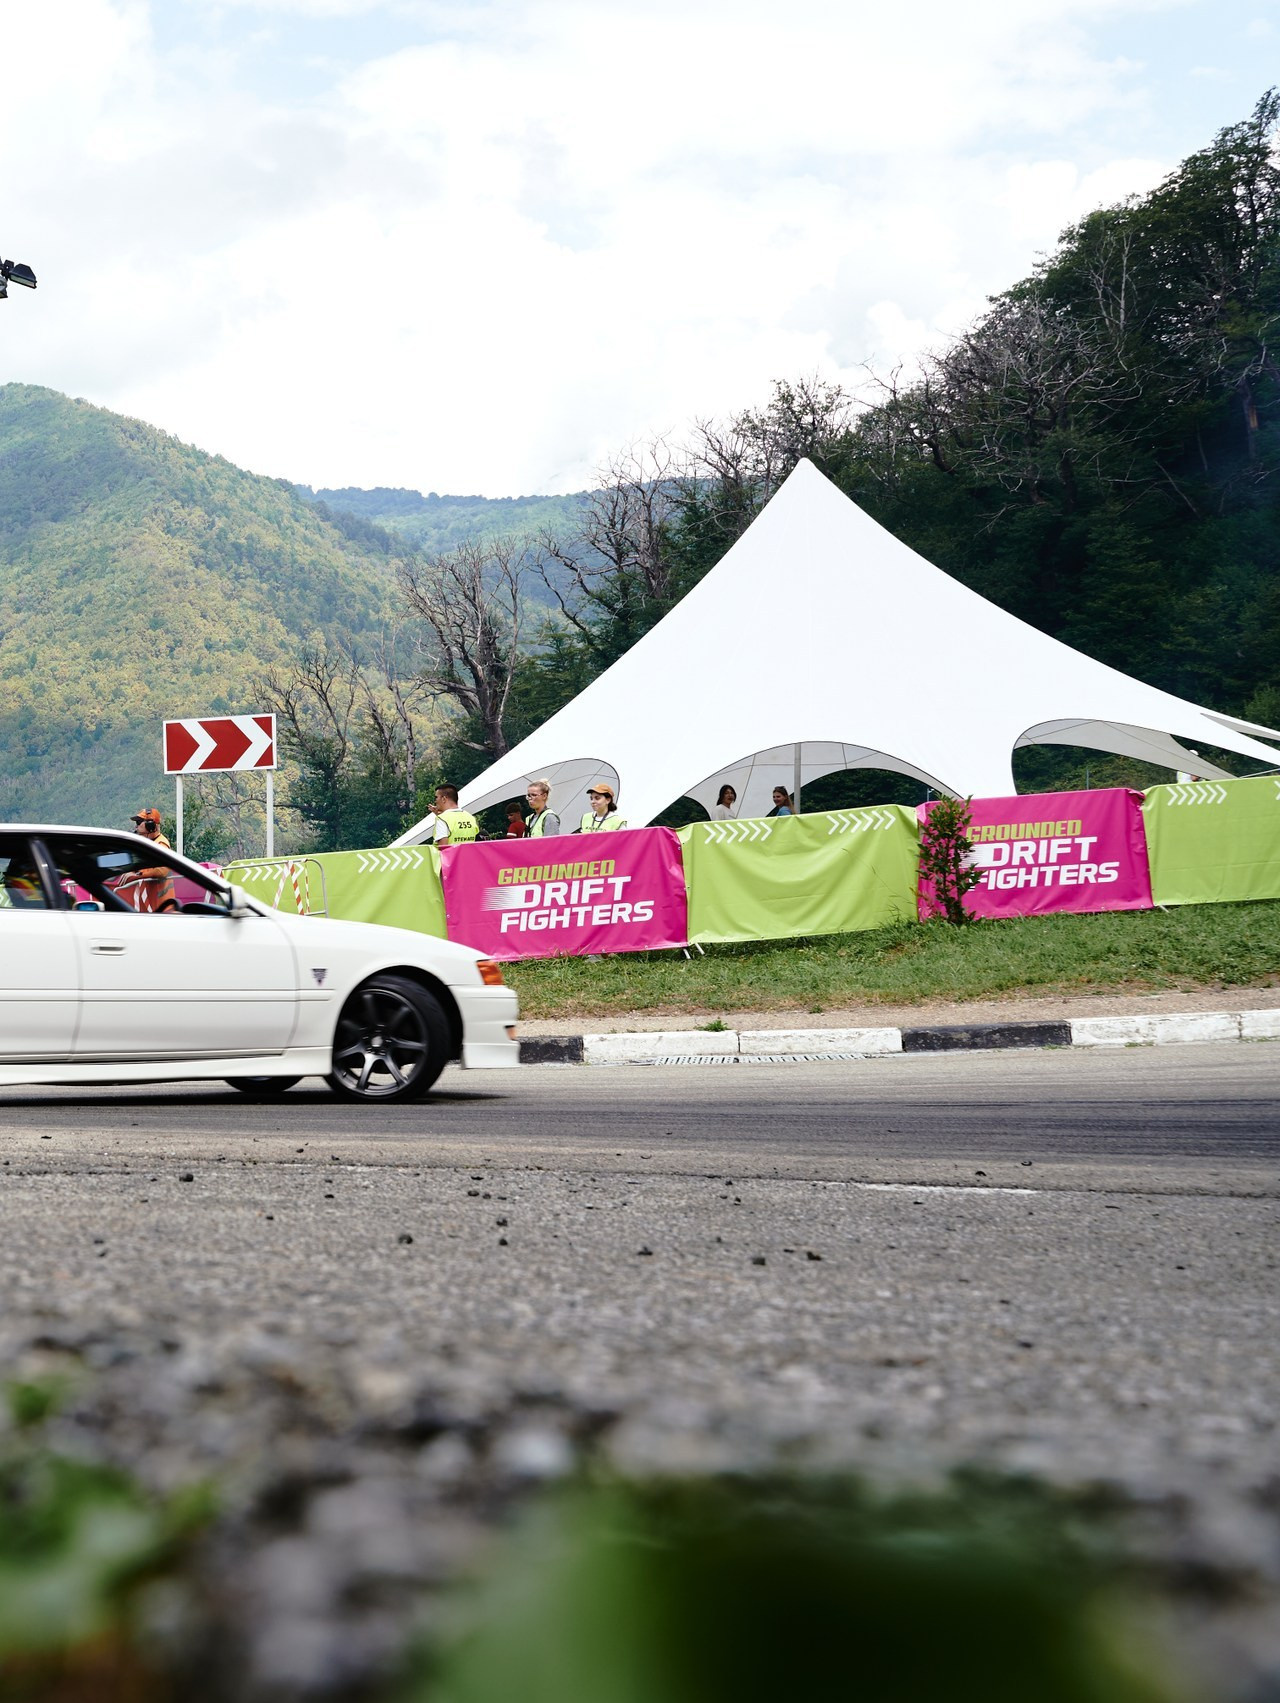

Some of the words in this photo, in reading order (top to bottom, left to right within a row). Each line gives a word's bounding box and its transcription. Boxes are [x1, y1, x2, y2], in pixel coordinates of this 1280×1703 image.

[458, 821, 472, 829] 255
[966, 819, 1082, 843] GROUNDED
[978, 836, 1098, 868] DRIFT
[497, 859, 616, 885] GROUNDED
[512, 875, 632, 910] DRIFT
[500, 900, 655, 933] FIGHTERS
